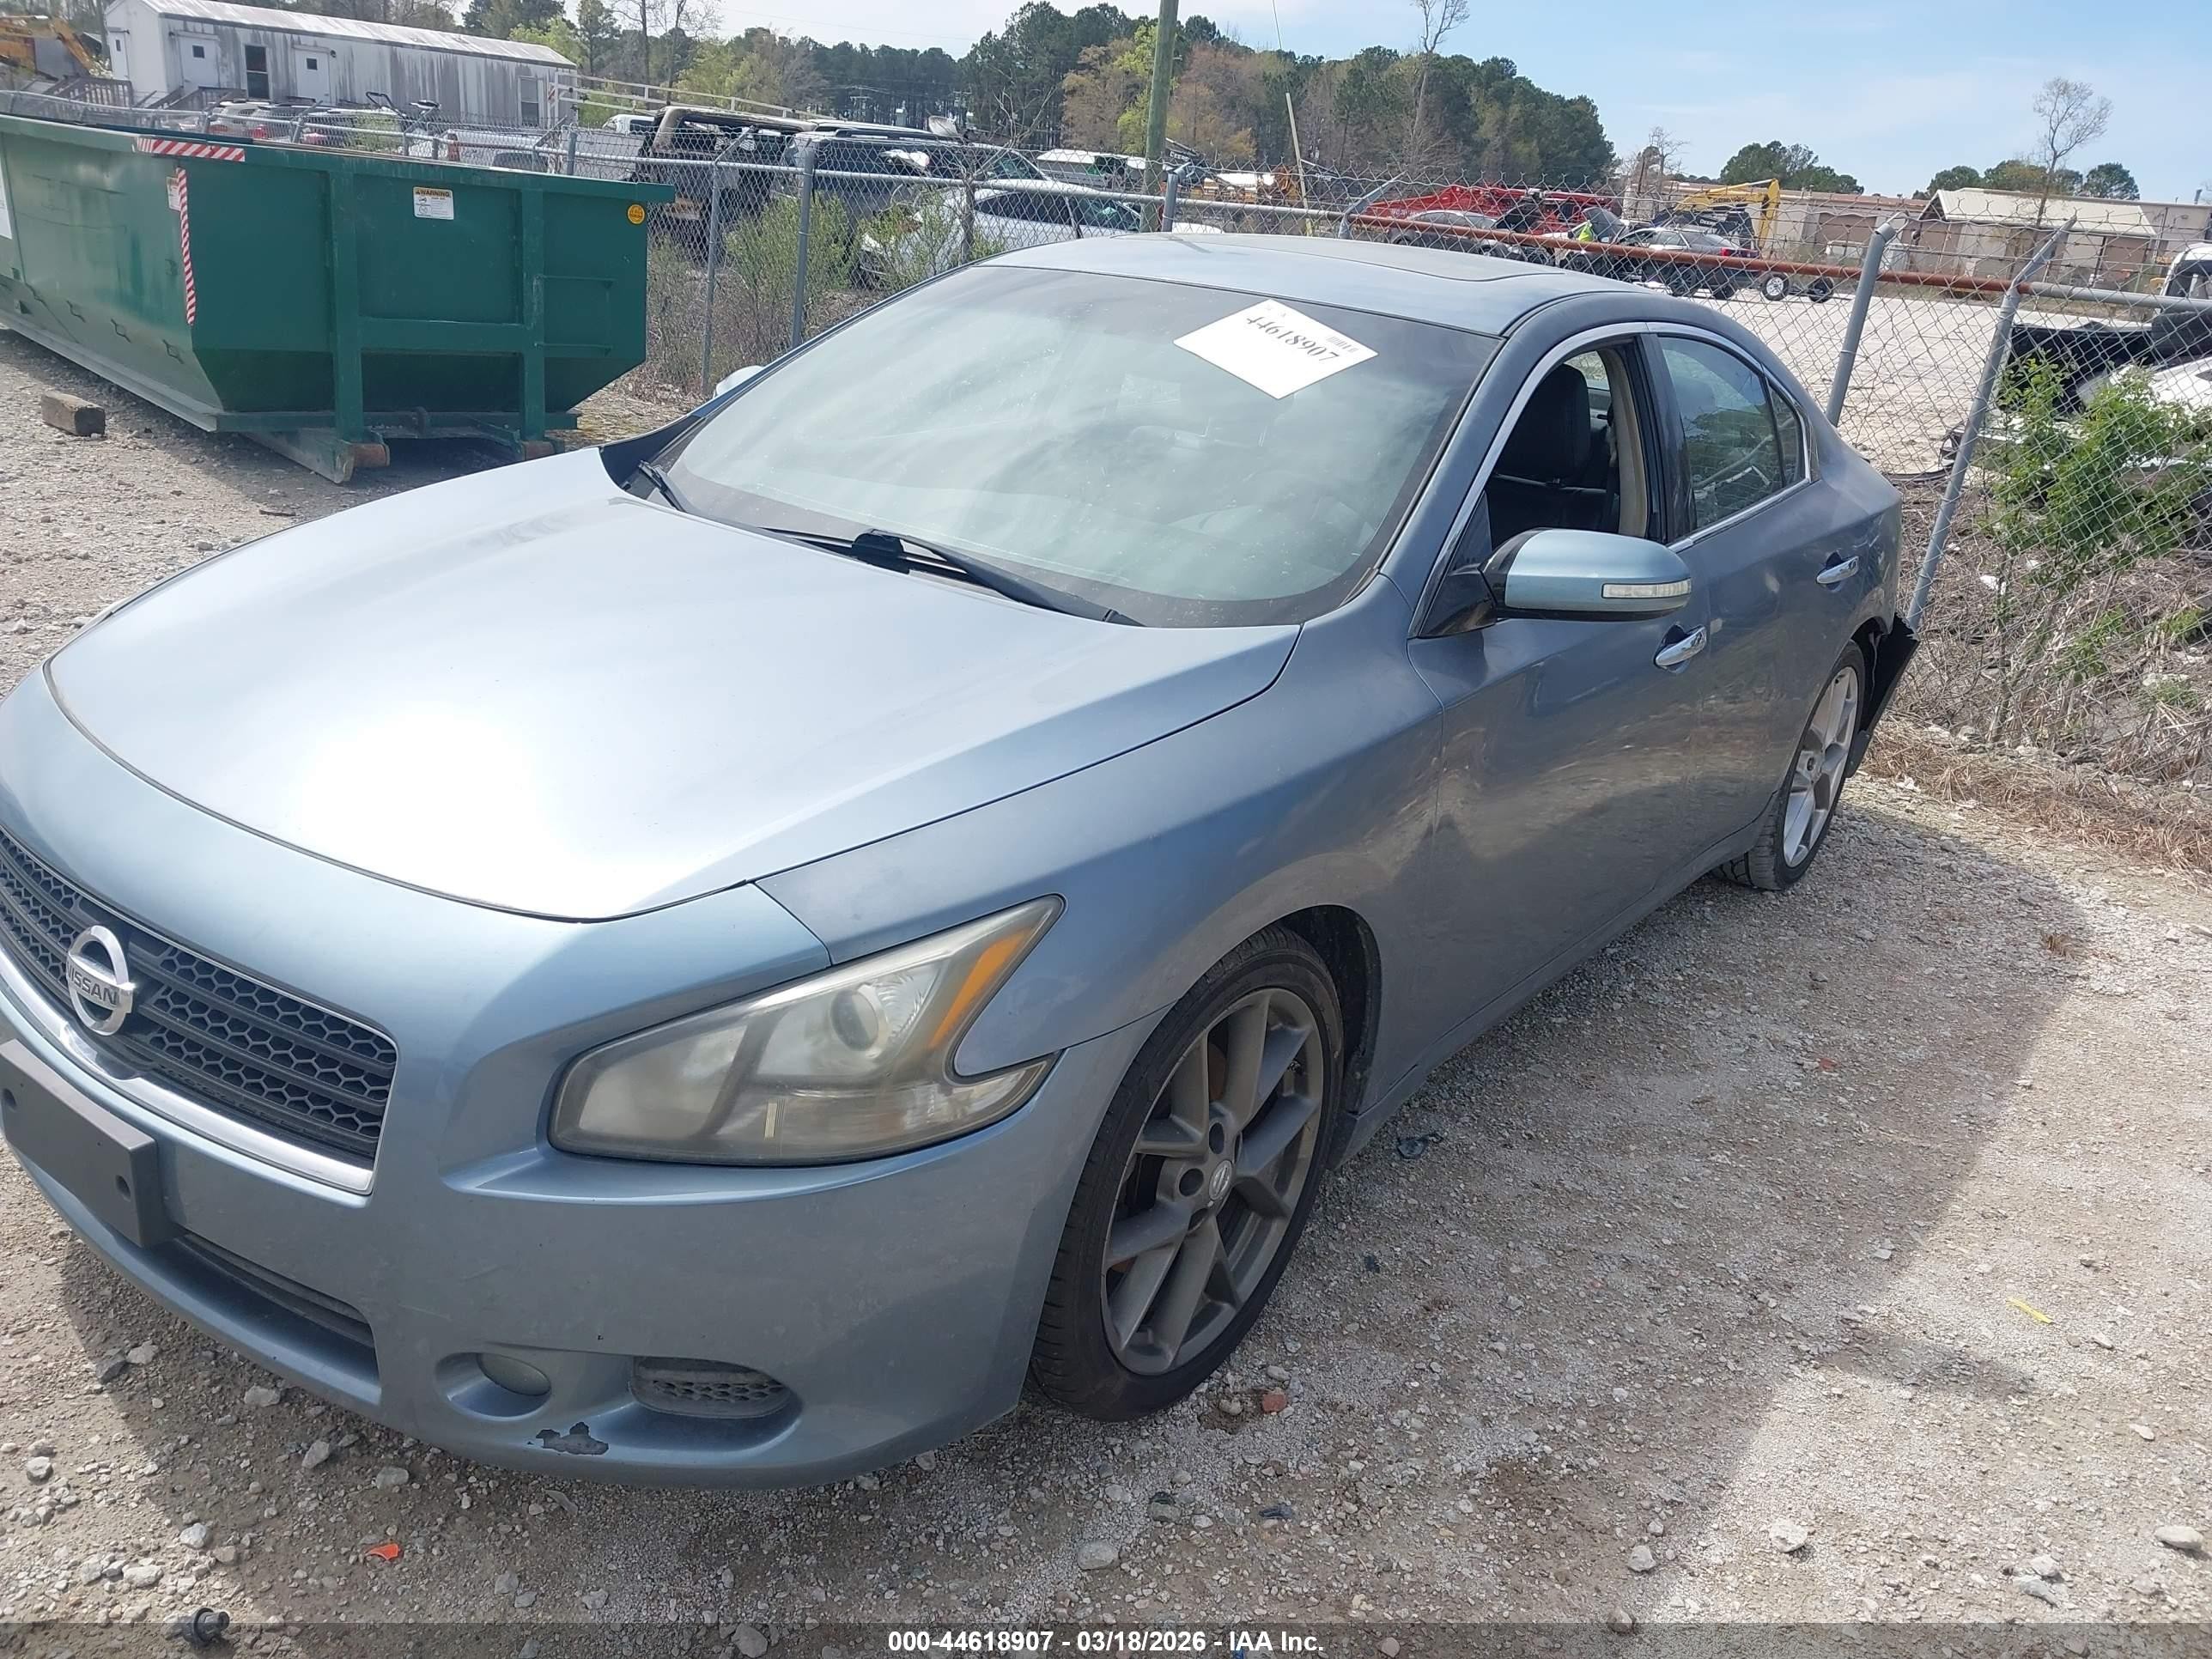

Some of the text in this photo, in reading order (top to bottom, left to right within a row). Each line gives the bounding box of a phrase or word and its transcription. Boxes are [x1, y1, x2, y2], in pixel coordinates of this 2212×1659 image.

[420, 189, 450, 198] WARNING
[1246, 316, 1340, 362] 44618907
[69, 963, 120, 1006] NISSAN
